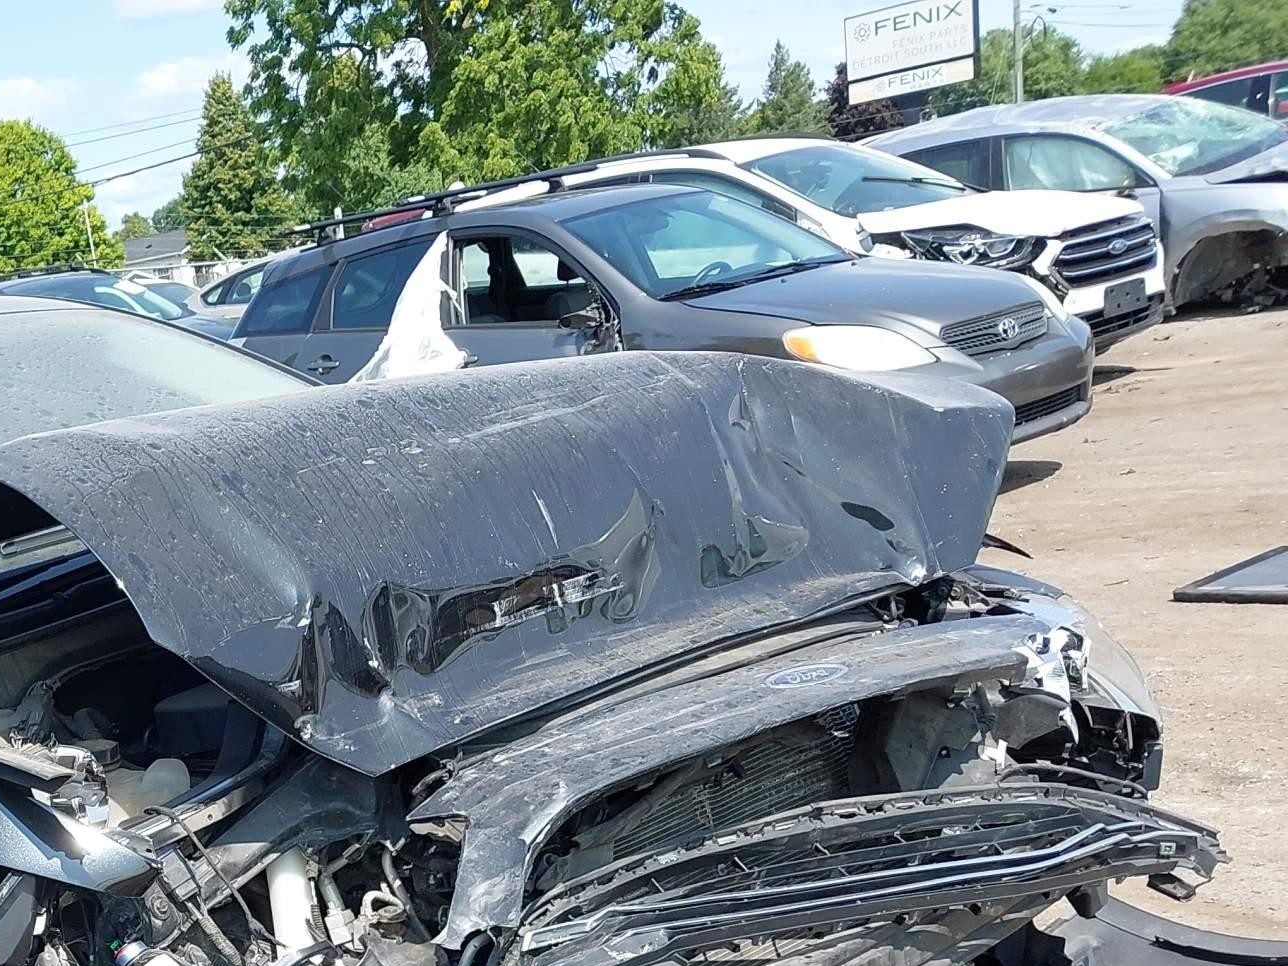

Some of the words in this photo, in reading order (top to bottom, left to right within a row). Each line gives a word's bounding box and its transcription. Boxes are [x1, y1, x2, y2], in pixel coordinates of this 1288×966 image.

[874, 1, 962, 36] FENIX
[892, 33, 926, 49] FENIX
[929, 24, 968, 40] PARTS
[888, 65, 945, 89] FENIX
